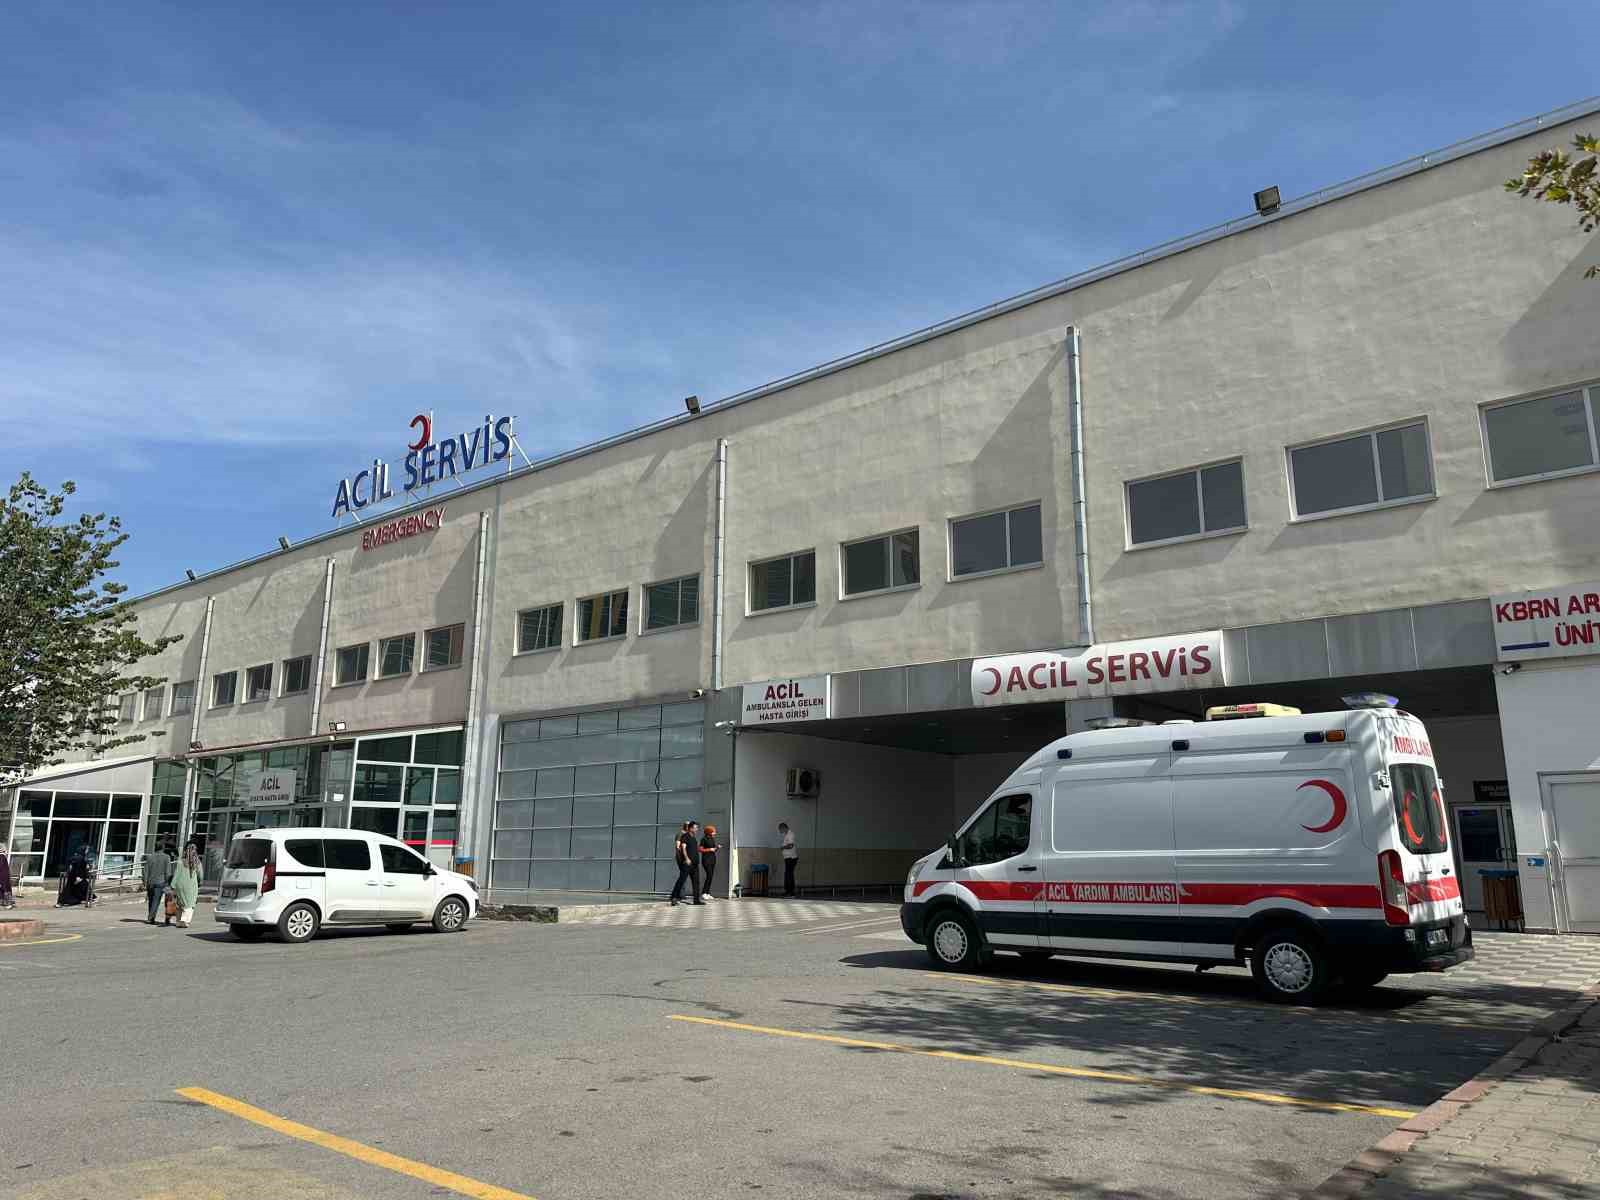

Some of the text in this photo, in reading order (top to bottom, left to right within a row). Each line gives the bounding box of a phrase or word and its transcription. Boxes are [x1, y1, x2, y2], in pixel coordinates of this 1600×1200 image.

[332, 414, 512, 517] ACİL SERVİS
[362, 505, 446, 552] EMERGENCY
[1496, 597, 1560, 623] KBRN
[765, 679, 804, 701] ACİL
[746, 698, 824, 711] AMBULANSLA GELEN
[760, 711, 784, 720] HASTA
[1072, 885, 1110, 901] YARDIM
[1113, 885, 1176, 902] AMBULANSI
